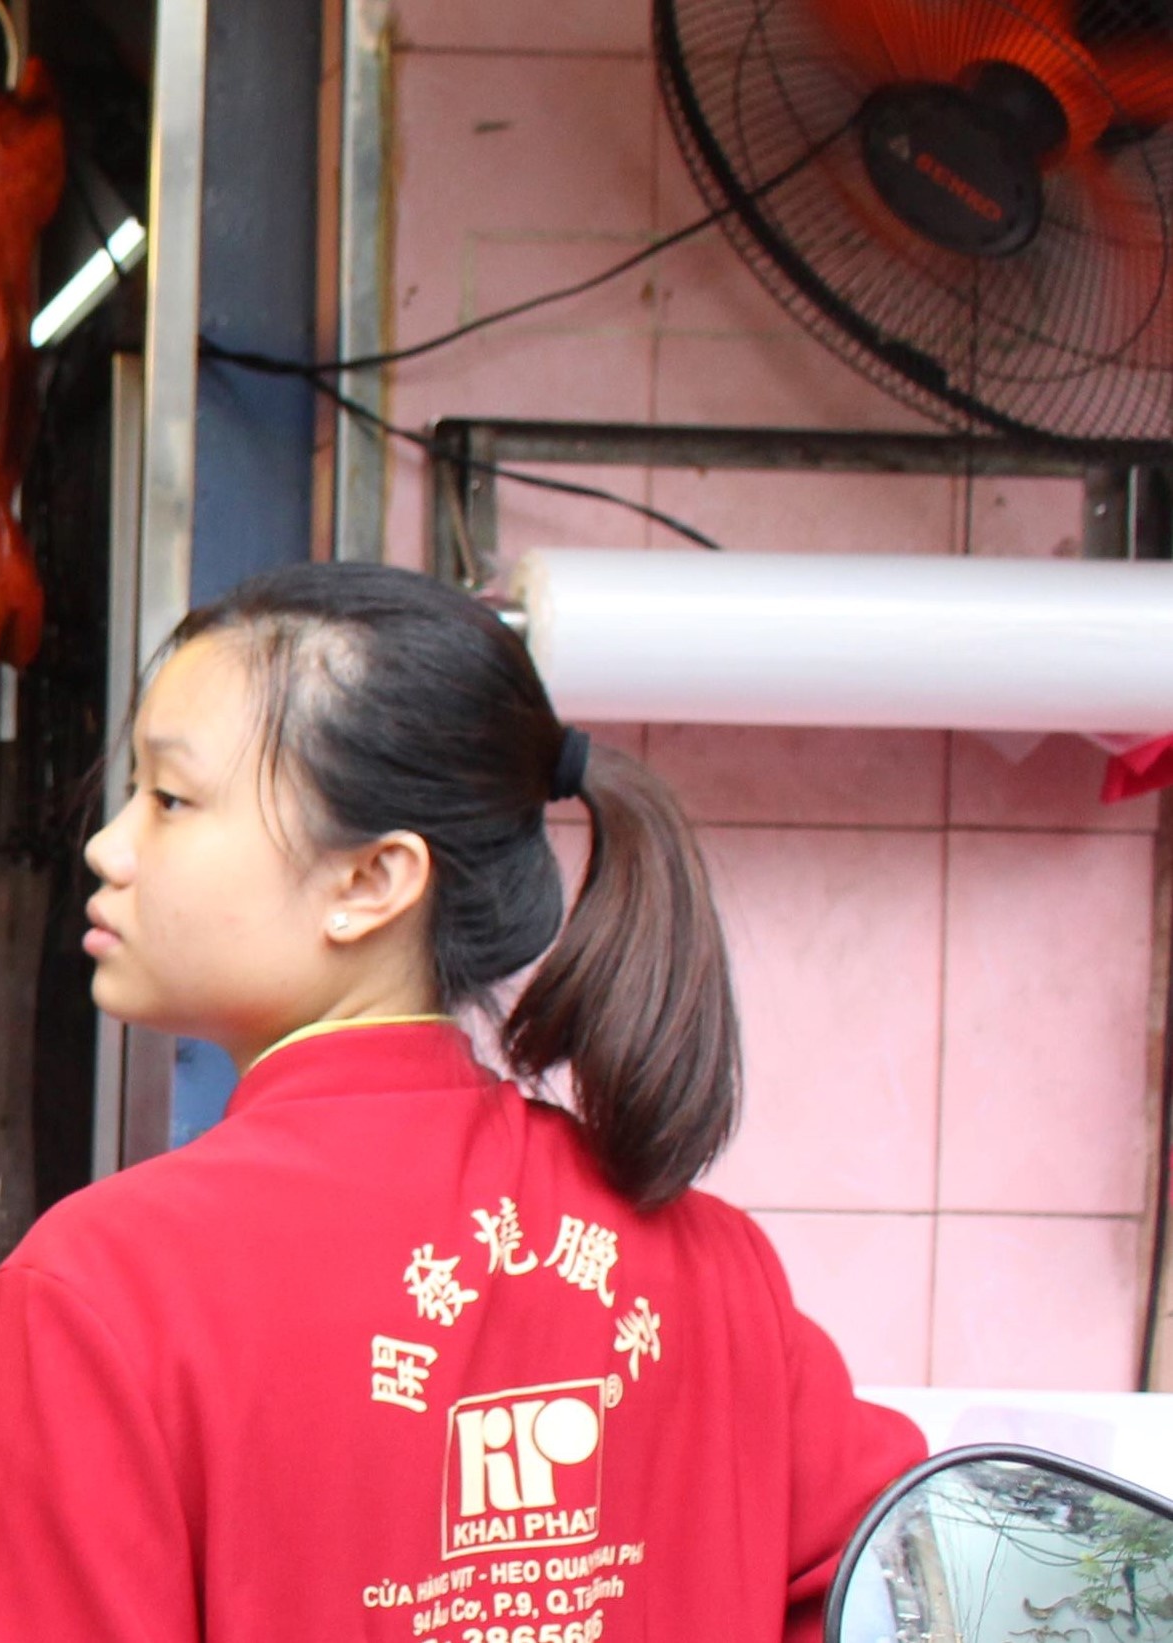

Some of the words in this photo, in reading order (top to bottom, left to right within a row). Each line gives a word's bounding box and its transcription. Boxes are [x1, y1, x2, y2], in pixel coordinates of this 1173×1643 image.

[453, 1515, 516, 1548] KHAI
[524, 1506, 597, 1538] PHAT
[363, 1578, 414, 1607] CỬA
[490, 1559, 541, 1585] HEO
[493, 1592, 539, 1620] P.9,
